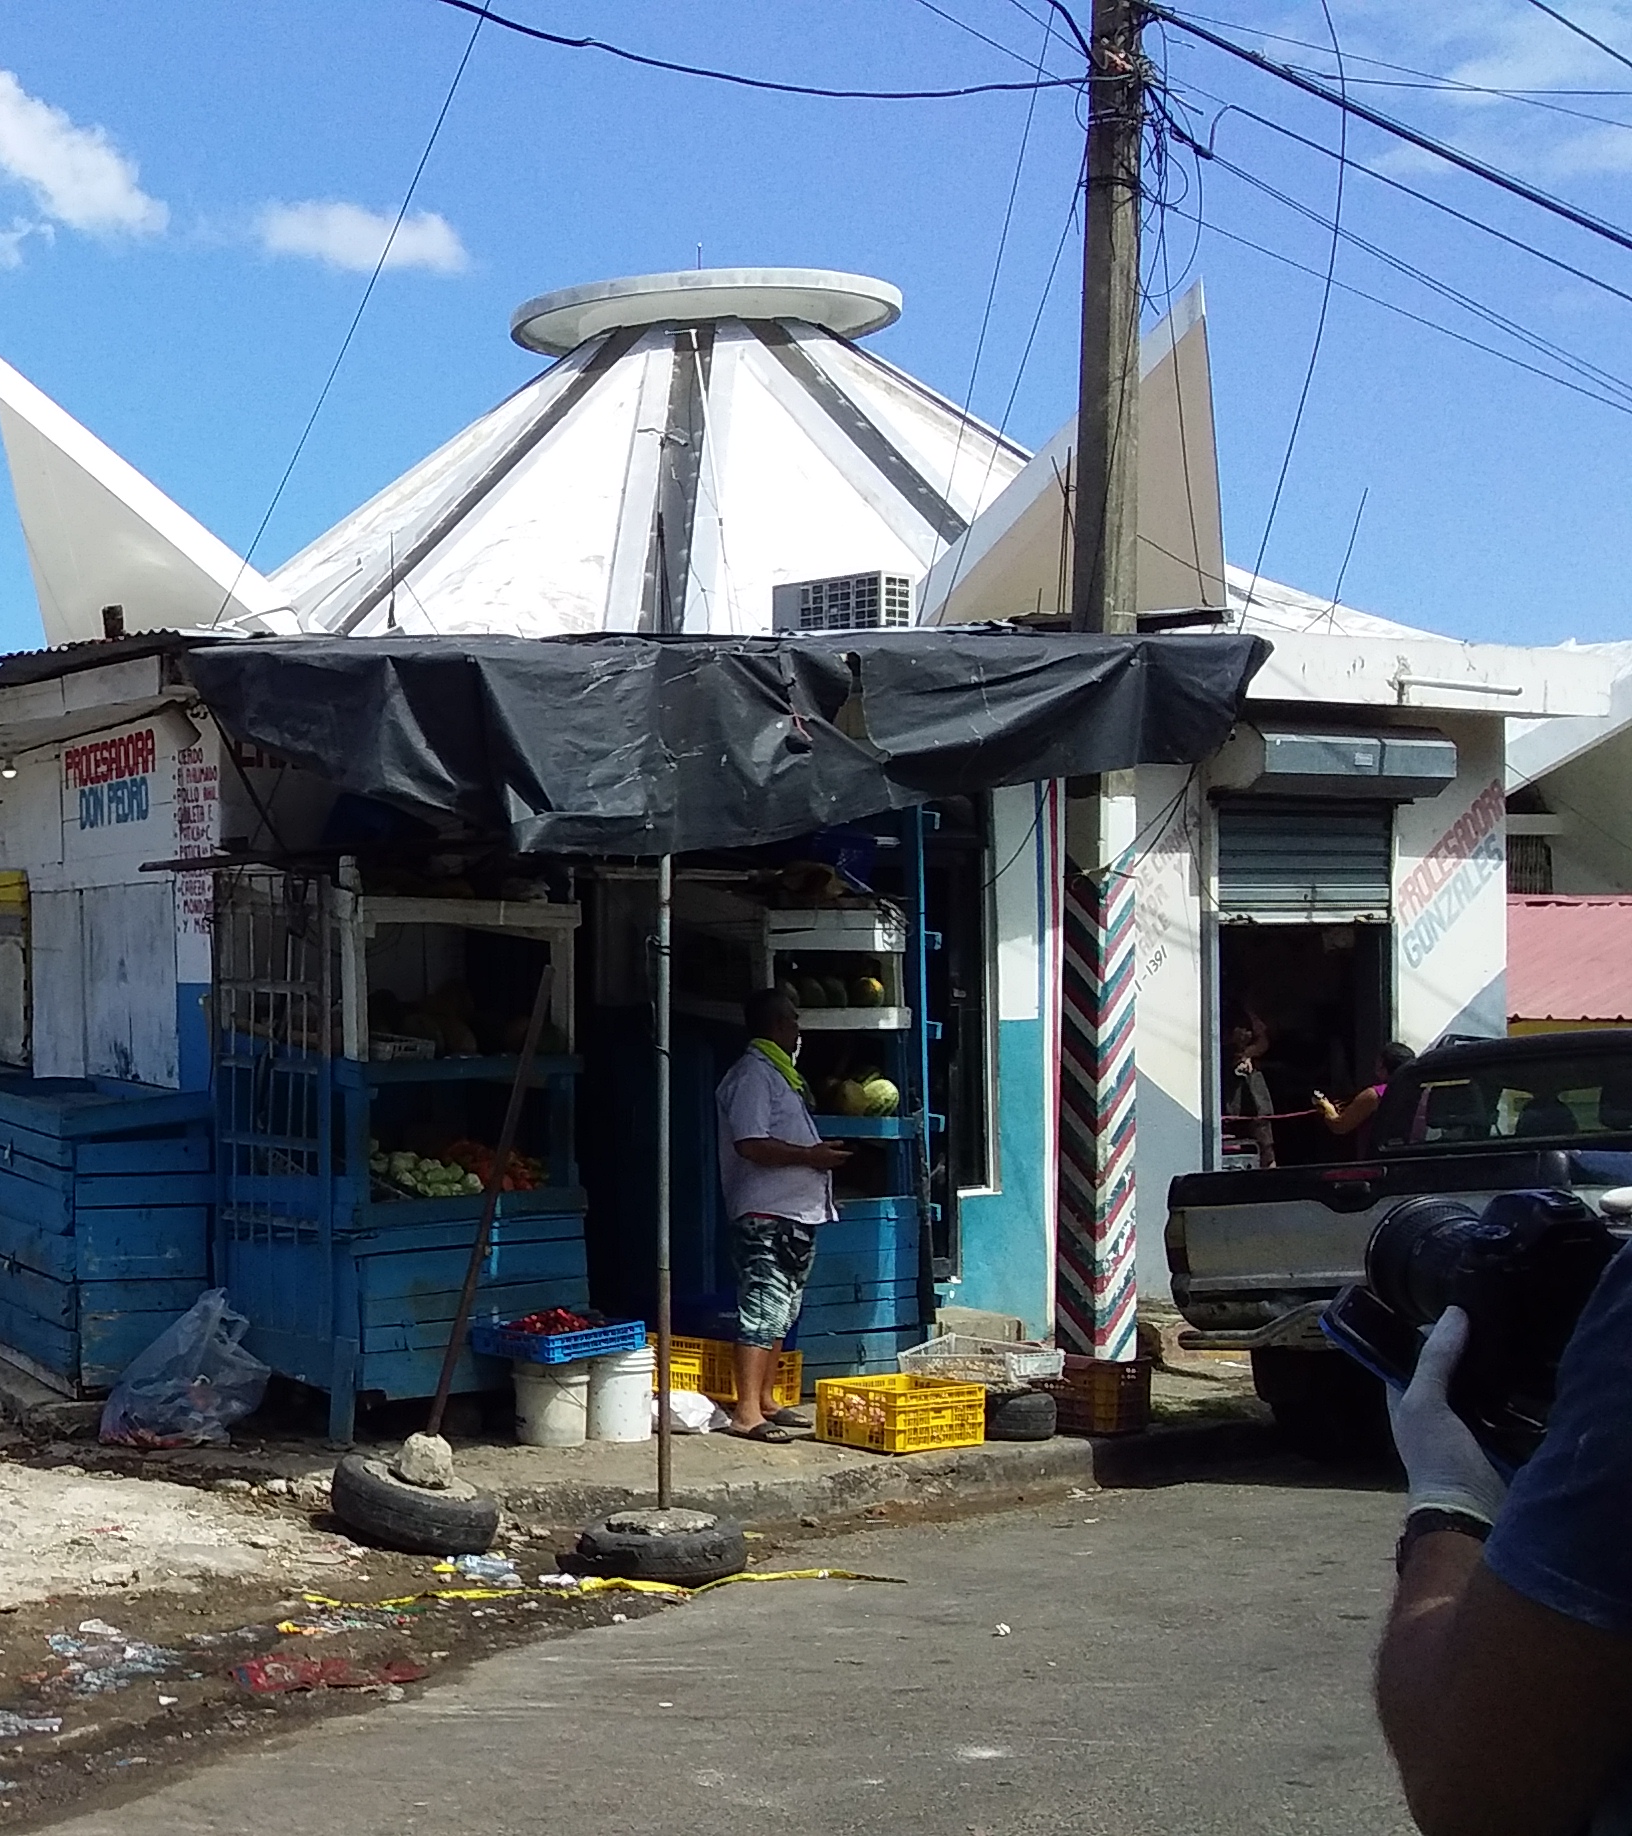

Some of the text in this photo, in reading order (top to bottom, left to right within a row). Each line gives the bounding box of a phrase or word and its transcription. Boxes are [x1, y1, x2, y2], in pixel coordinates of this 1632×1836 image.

[65, 728, 156, 790] PROCESADORA
[79, 775, 149, 831] DON PEDRO
[1396, 778, 1506, 927] PROCESADORA
[1401, 832, 1505, 970] GONZALES
[1134, 944, 1168, 993] 1-1391
